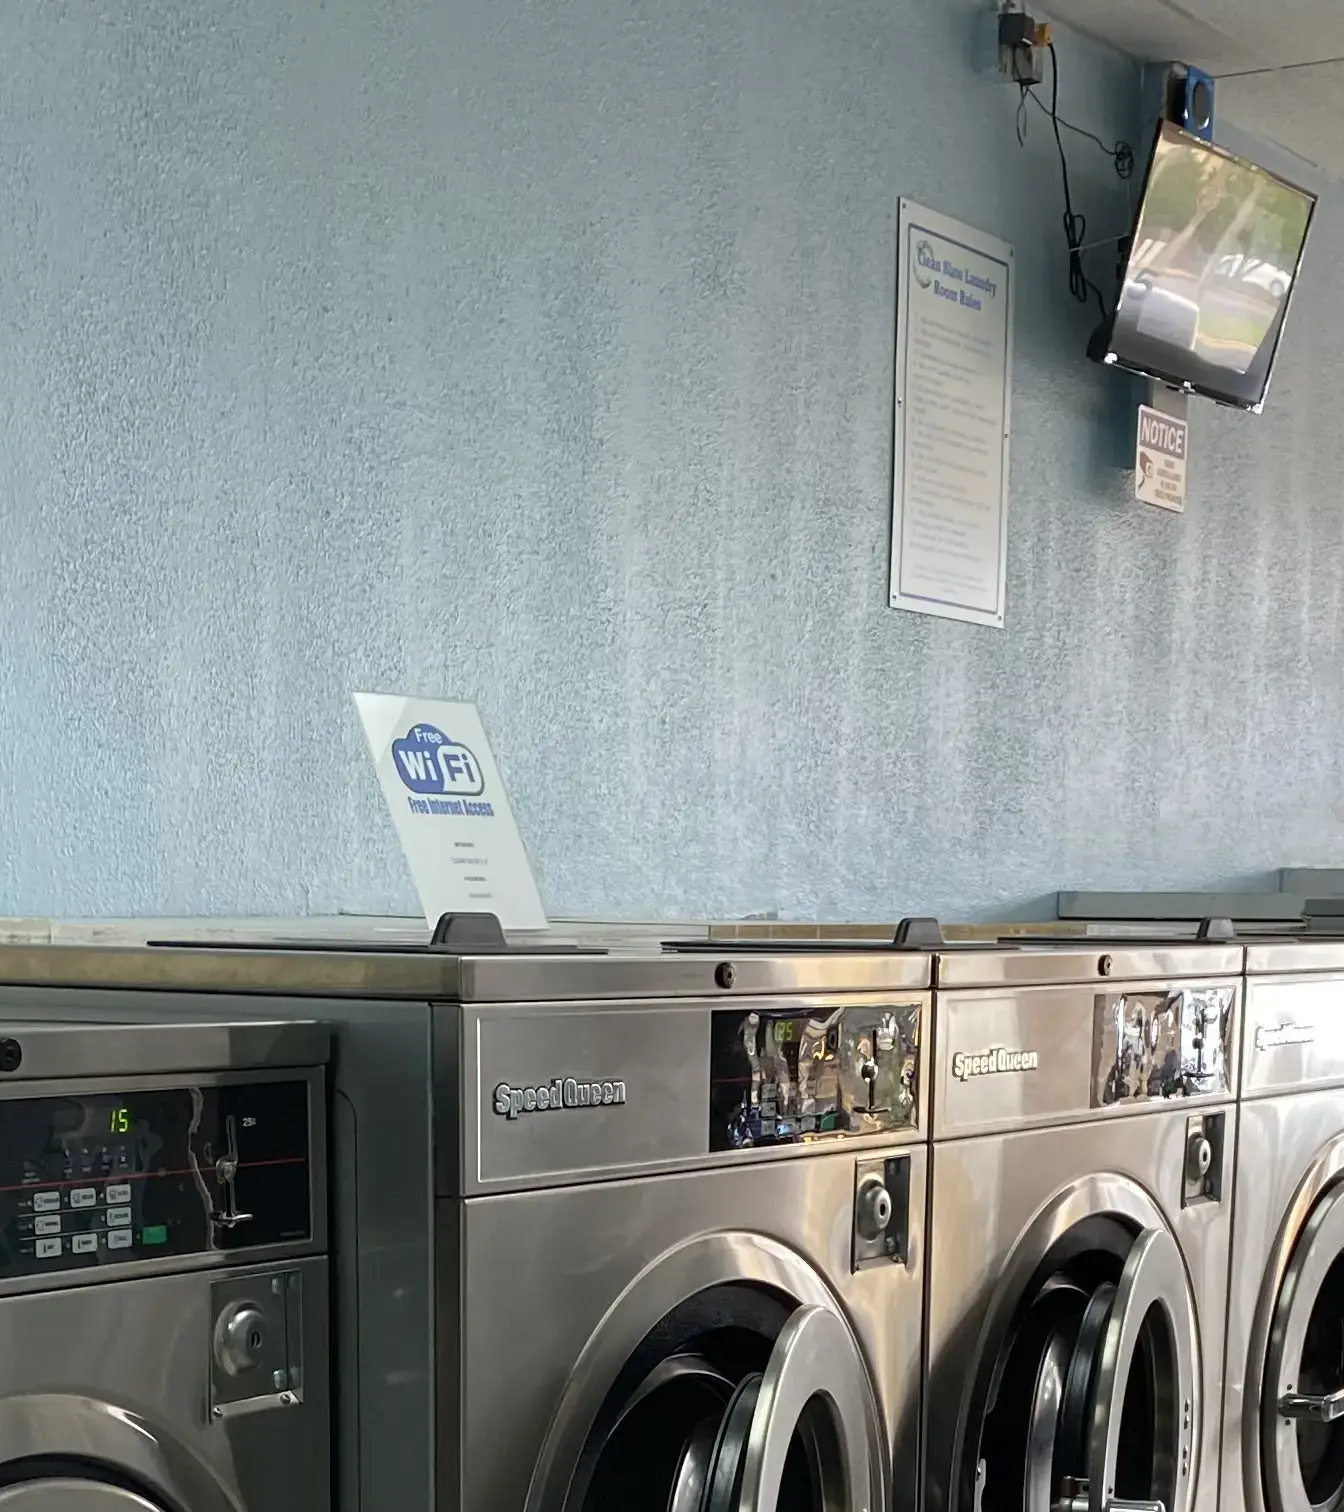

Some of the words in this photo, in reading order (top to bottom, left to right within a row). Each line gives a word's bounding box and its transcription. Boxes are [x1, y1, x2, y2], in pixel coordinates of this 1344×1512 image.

[964, 268, 997, 300] Laundry
[1141, 416, 1184, 454] NOTICE
[414, 728, 443, 744] Free
[408, 796, 430, 815] Free
[427, 798, 465, 816] Internet
[952, 1048, 997, 1082] Speed
[997, 1048, 1038, 1072] Queen
[492, 1078, 563, 1120] Speed
[562, 1077, 626, 1107] Queen
[111, 1108, 128, 1132] 15
